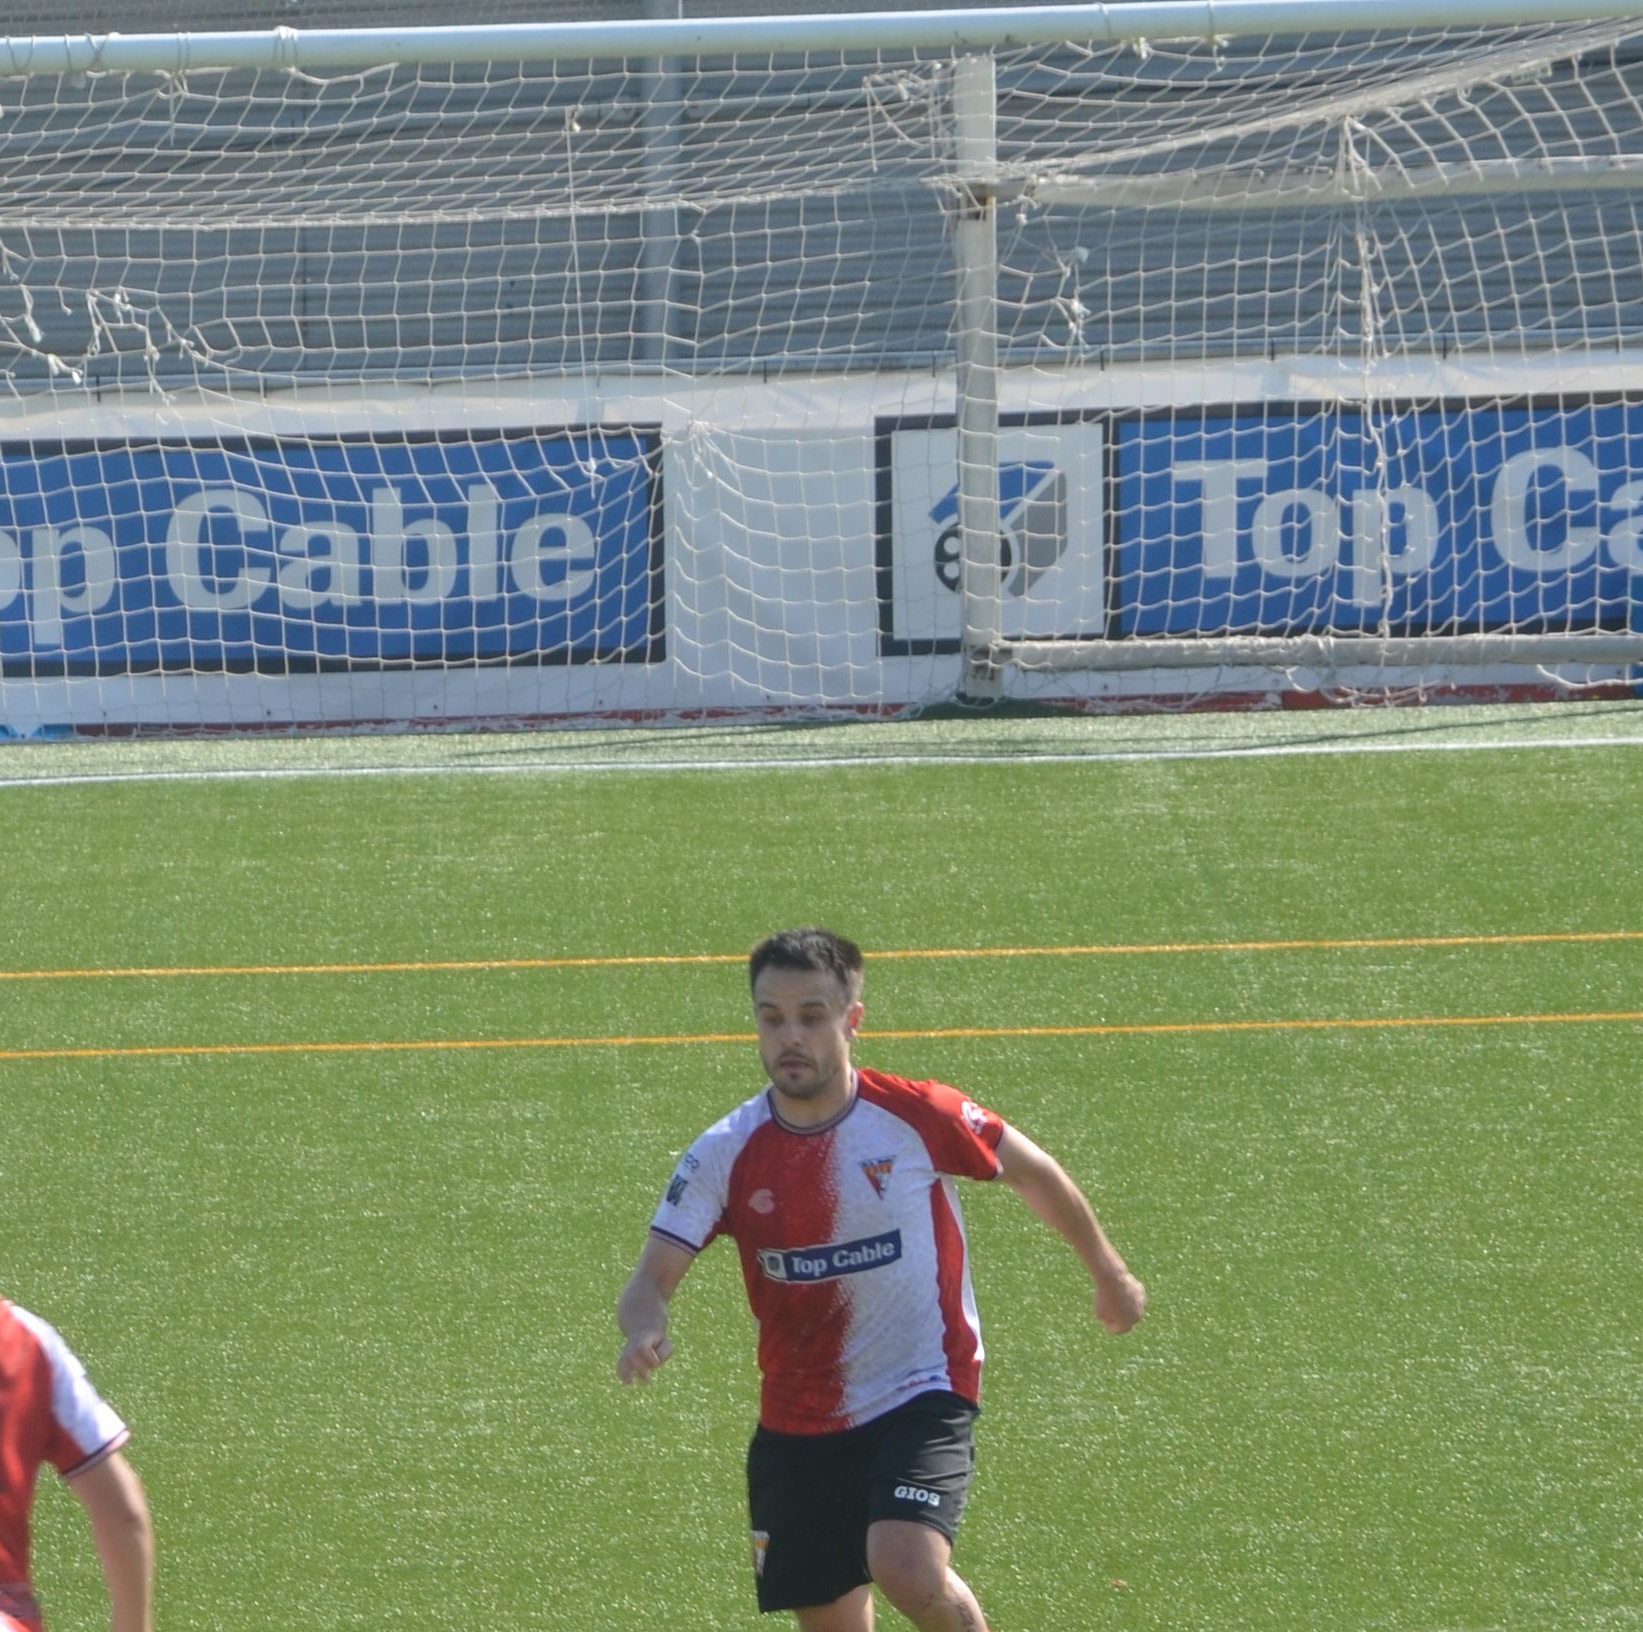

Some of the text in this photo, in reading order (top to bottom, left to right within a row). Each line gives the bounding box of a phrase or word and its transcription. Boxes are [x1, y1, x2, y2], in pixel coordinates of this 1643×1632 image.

[165, 483, 597, 608] Cable
[1172, 458, 1439, 608] Top
[792, 1242, 894, 1276] Top Cable
[894, 1485, 941, 1507] GIOS
